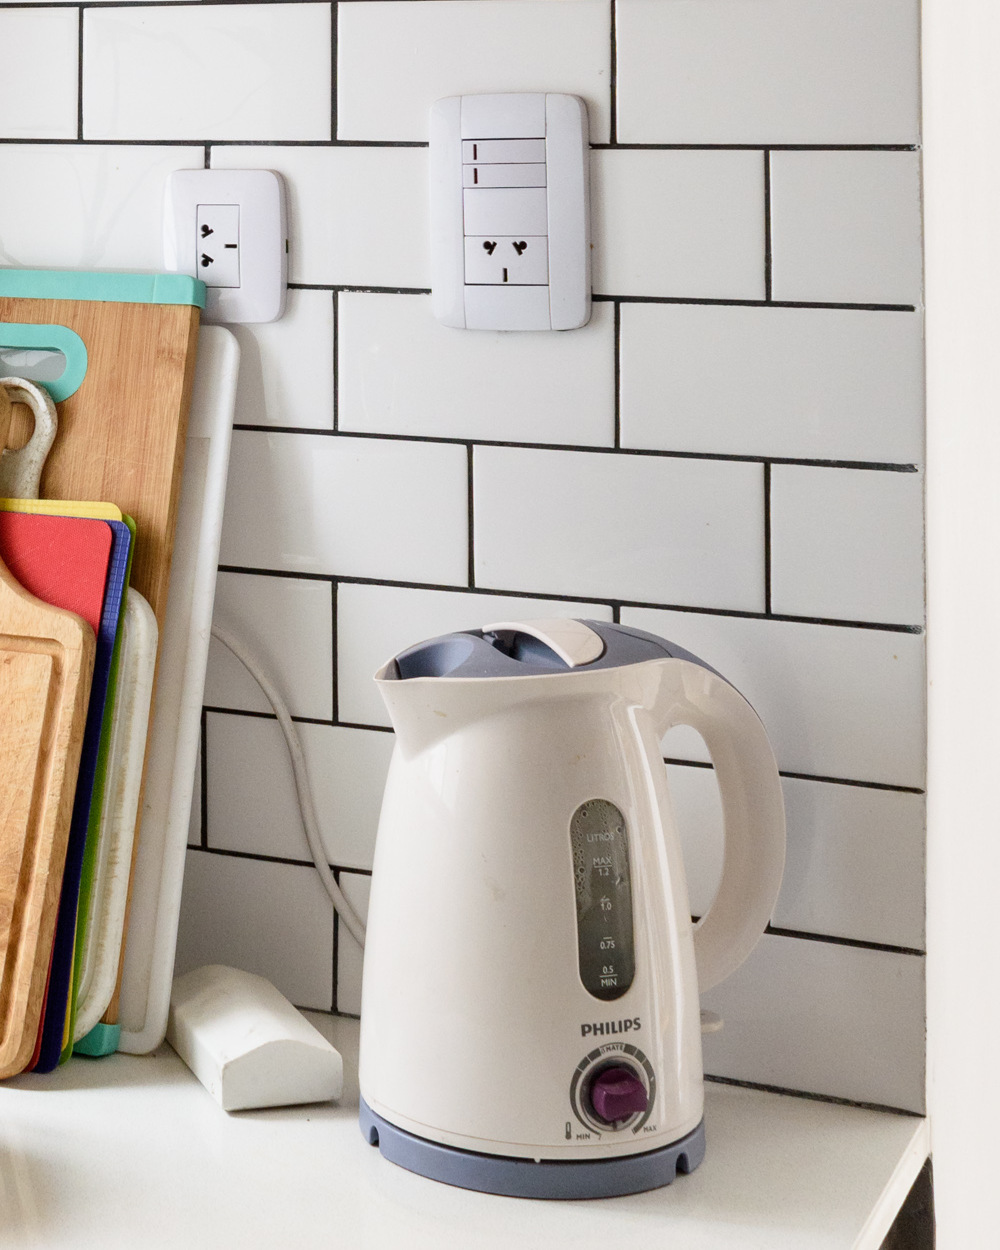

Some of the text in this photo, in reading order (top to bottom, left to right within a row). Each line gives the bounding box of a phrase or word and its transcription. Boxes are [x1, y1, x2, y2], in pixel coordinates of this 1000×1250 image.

[586, 831, 615, 843] LITROS
[592, 856, 613, 865] MAX
[598, 867, 611, 877] 1.2
[600, 901, 613, 911] 1.0
[600, 940, 616, 950] 0.75
[602, 965, 614, 974] 0.5
[601, 977, 617, 987] MIN
[580, 1017, 642, 1038] PHILIPS
[643, 1124, 657, 1133] MAX
[576, 1133, 591, 1141] MIN
